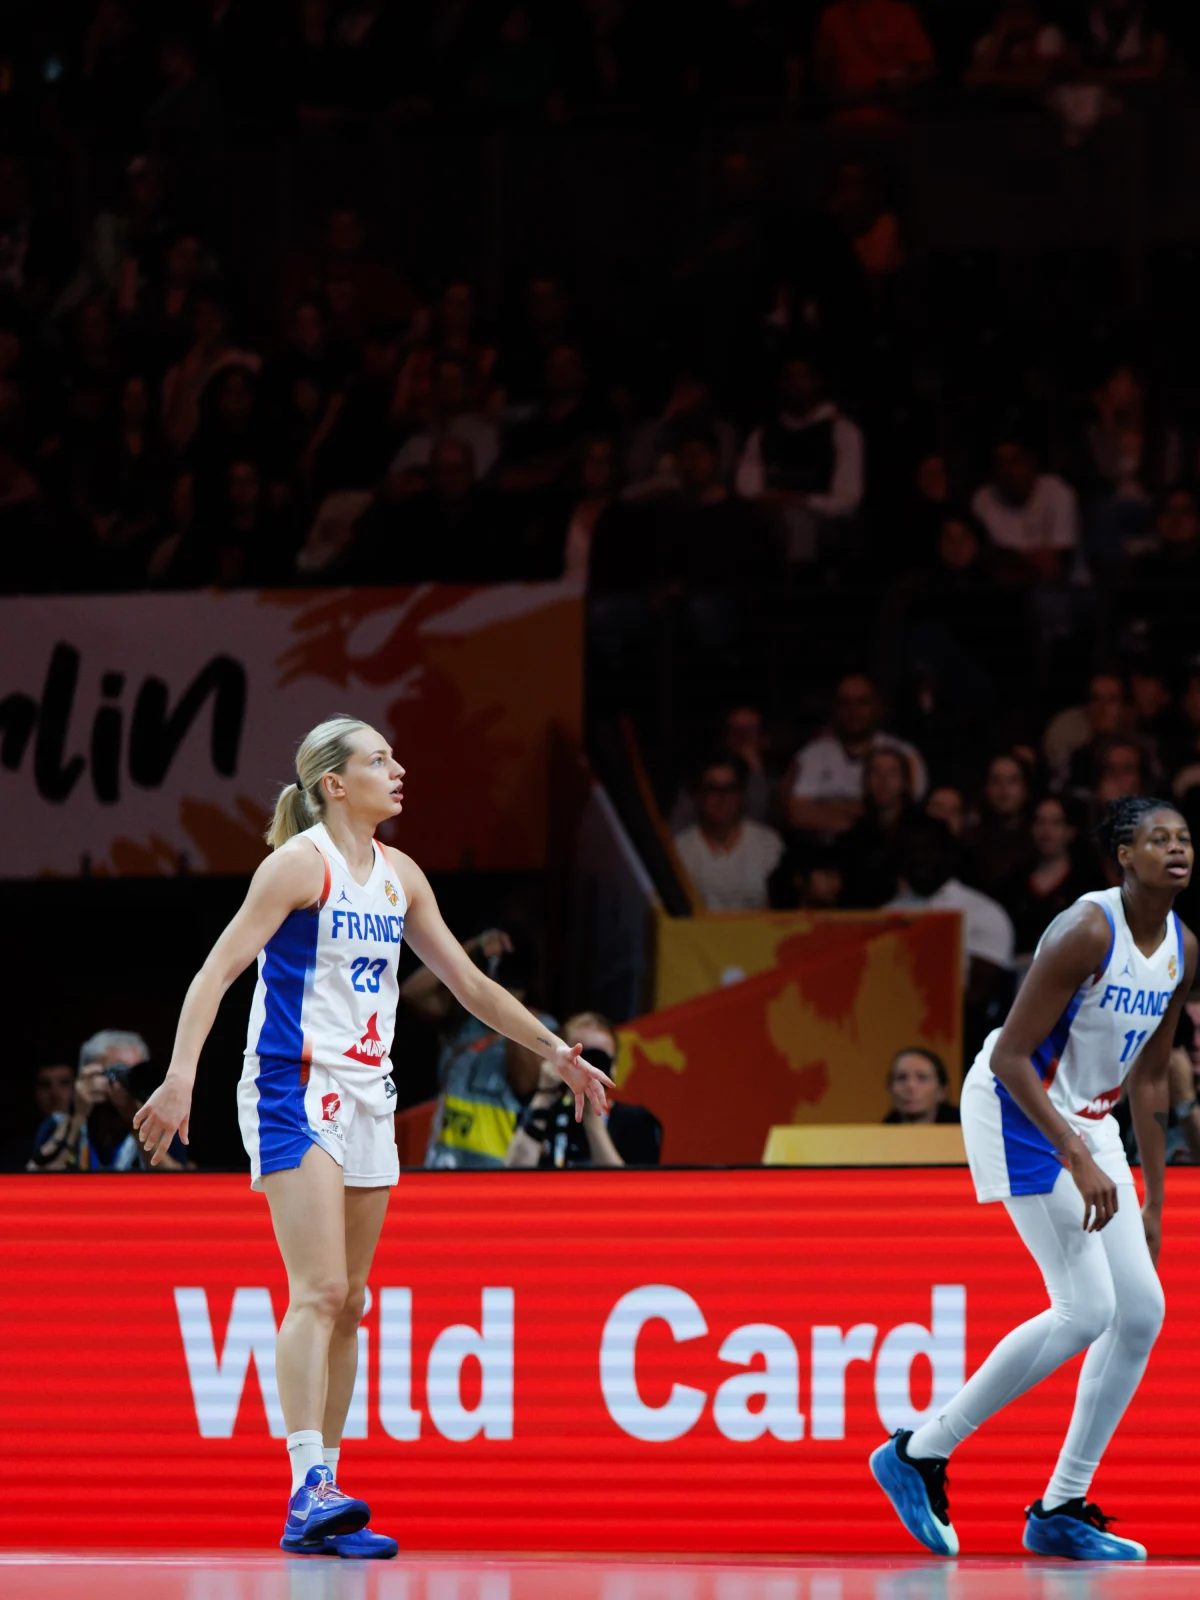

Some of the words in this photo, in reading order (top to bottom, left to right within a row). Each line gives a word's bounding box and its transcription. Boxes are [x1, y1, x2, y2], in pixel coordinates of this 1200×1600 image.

[350, 956, 388, 993] 23
[1119, 1029, 1148, 1063] 11
[175, 1286, 515, 1442] Wild
[600, 1283, 966, 1442] Card
